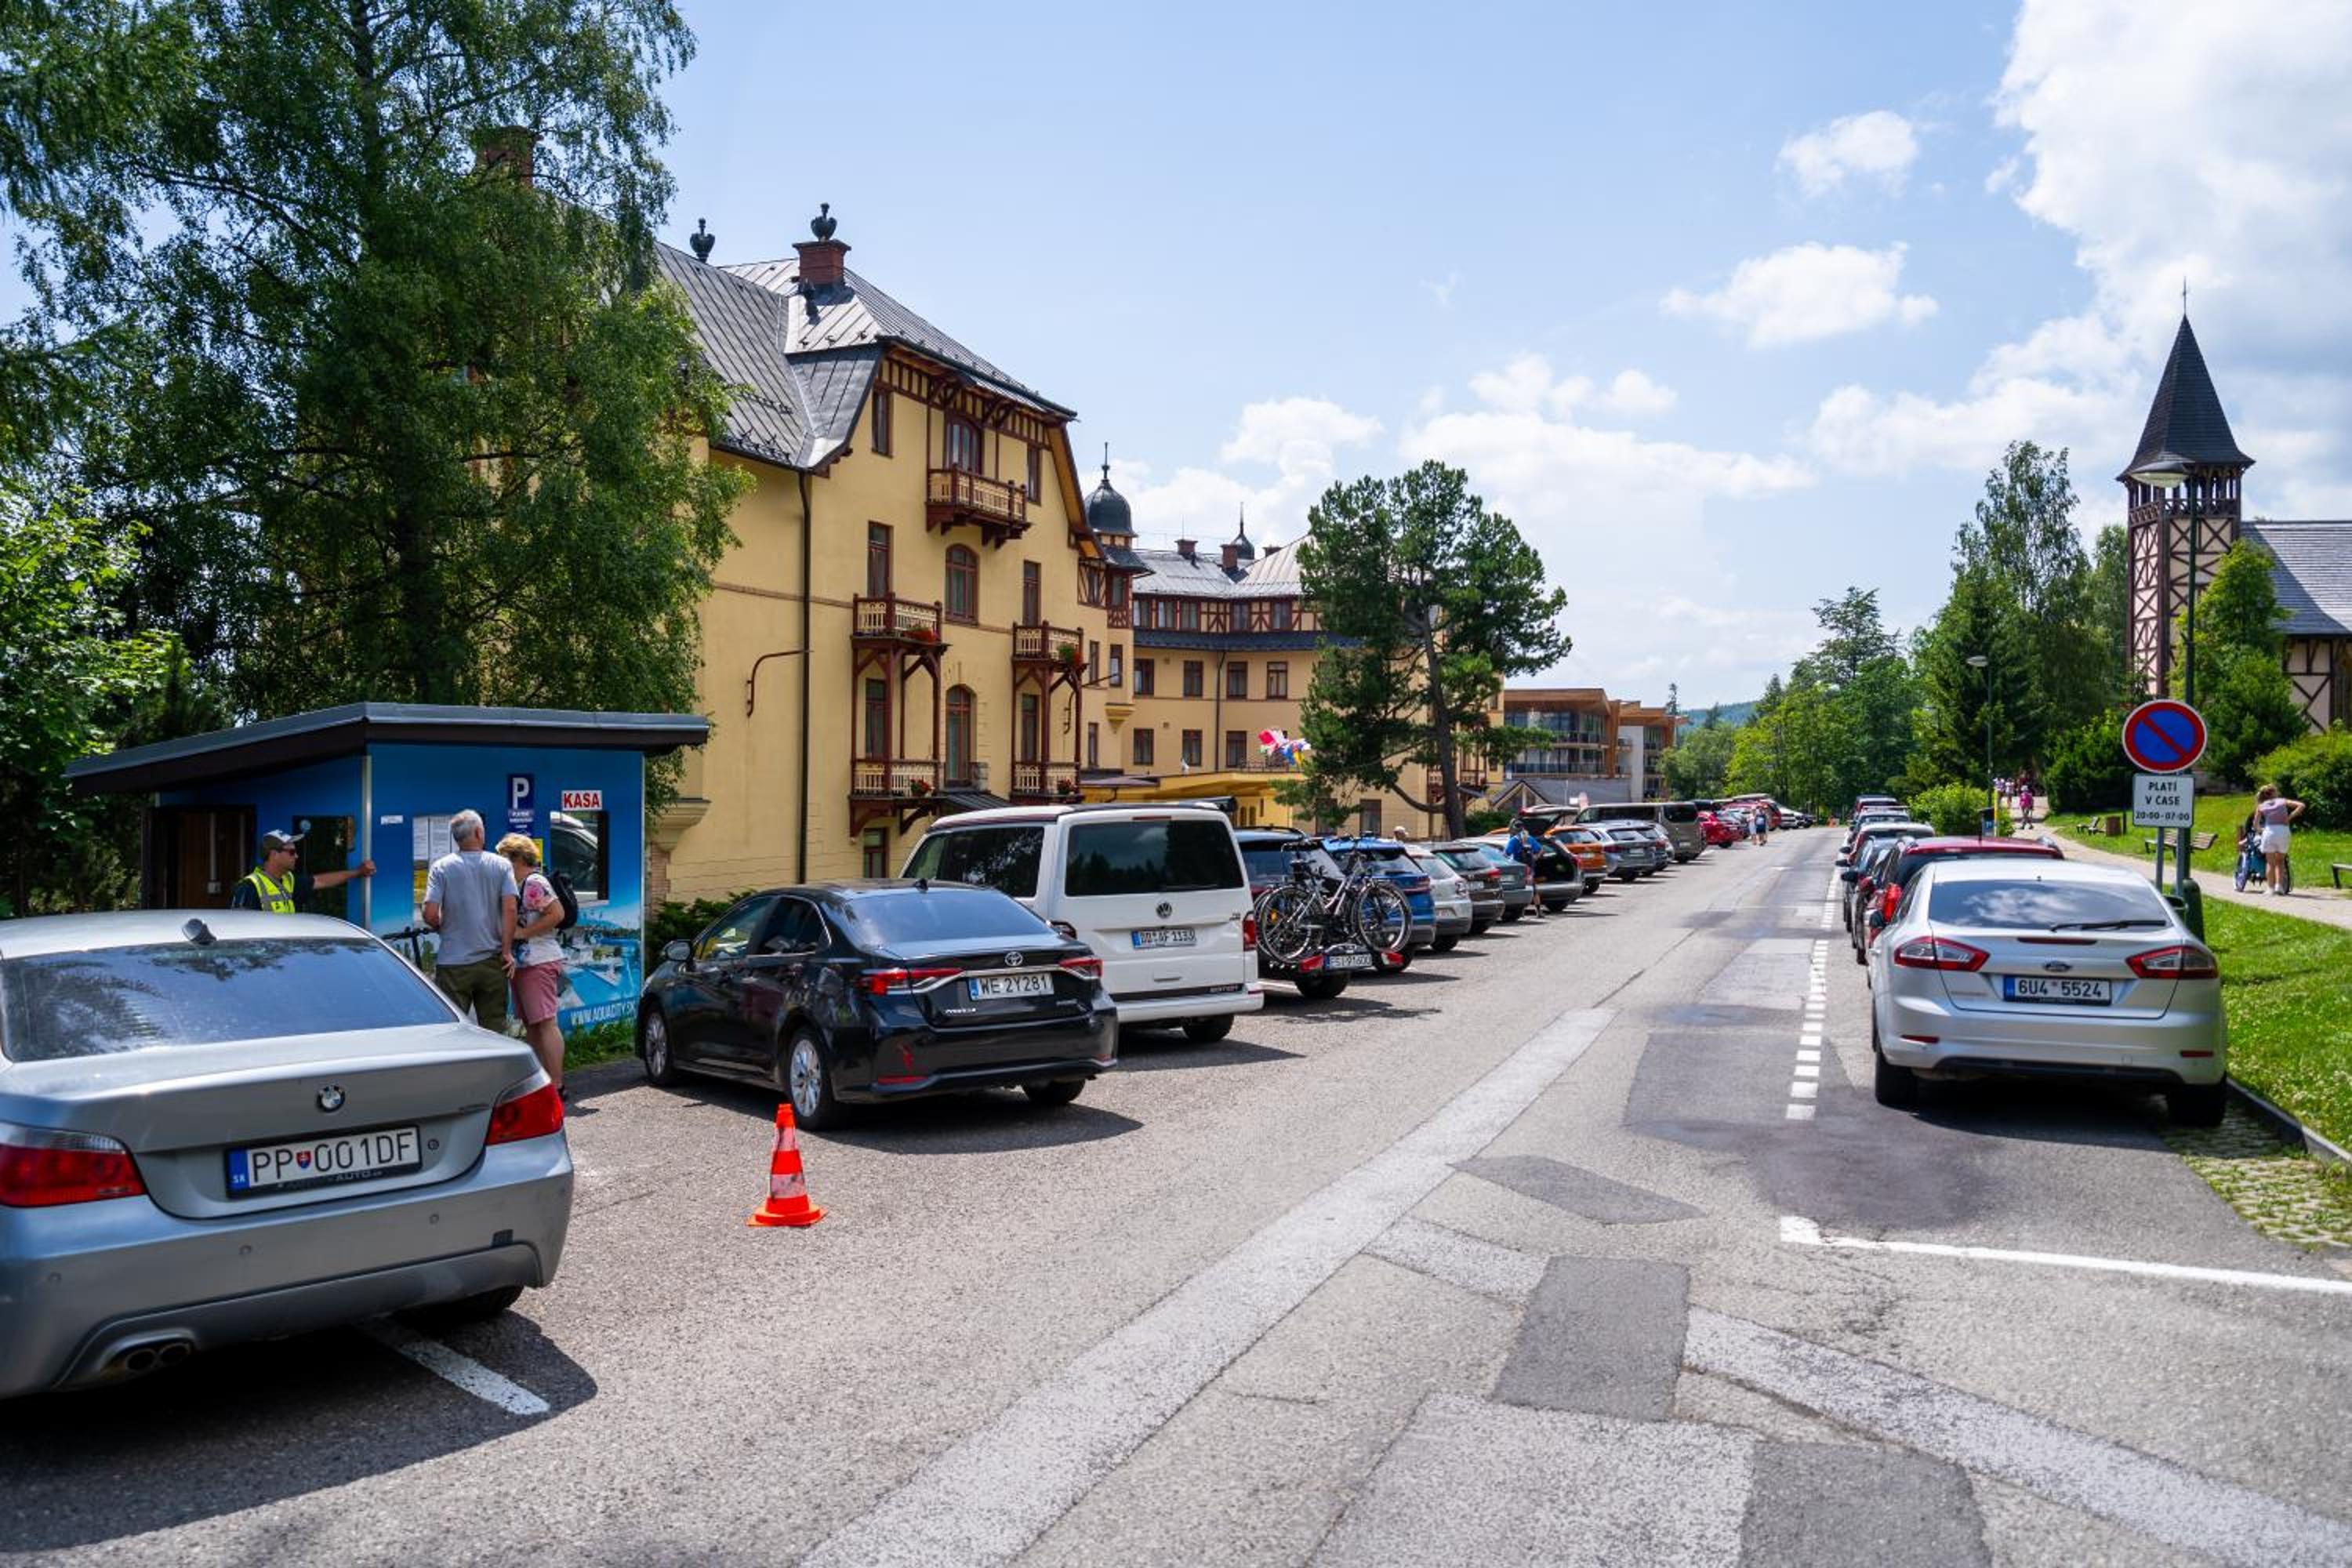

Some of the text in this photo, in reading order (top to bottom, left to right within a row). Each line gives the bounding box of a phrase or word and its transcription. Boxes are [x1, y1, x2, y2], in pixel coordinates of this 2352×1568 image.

[512, 777, 530, 809] P
[563, 793, 600, 808] KASA
[2144, 795, 2152, 805] V
[981, 975, 1049, 994] WE 2Y281
[2018, 979, 2103, 998] 6U4 5524
[252, 1131, 413, 1182] PP 001DF
